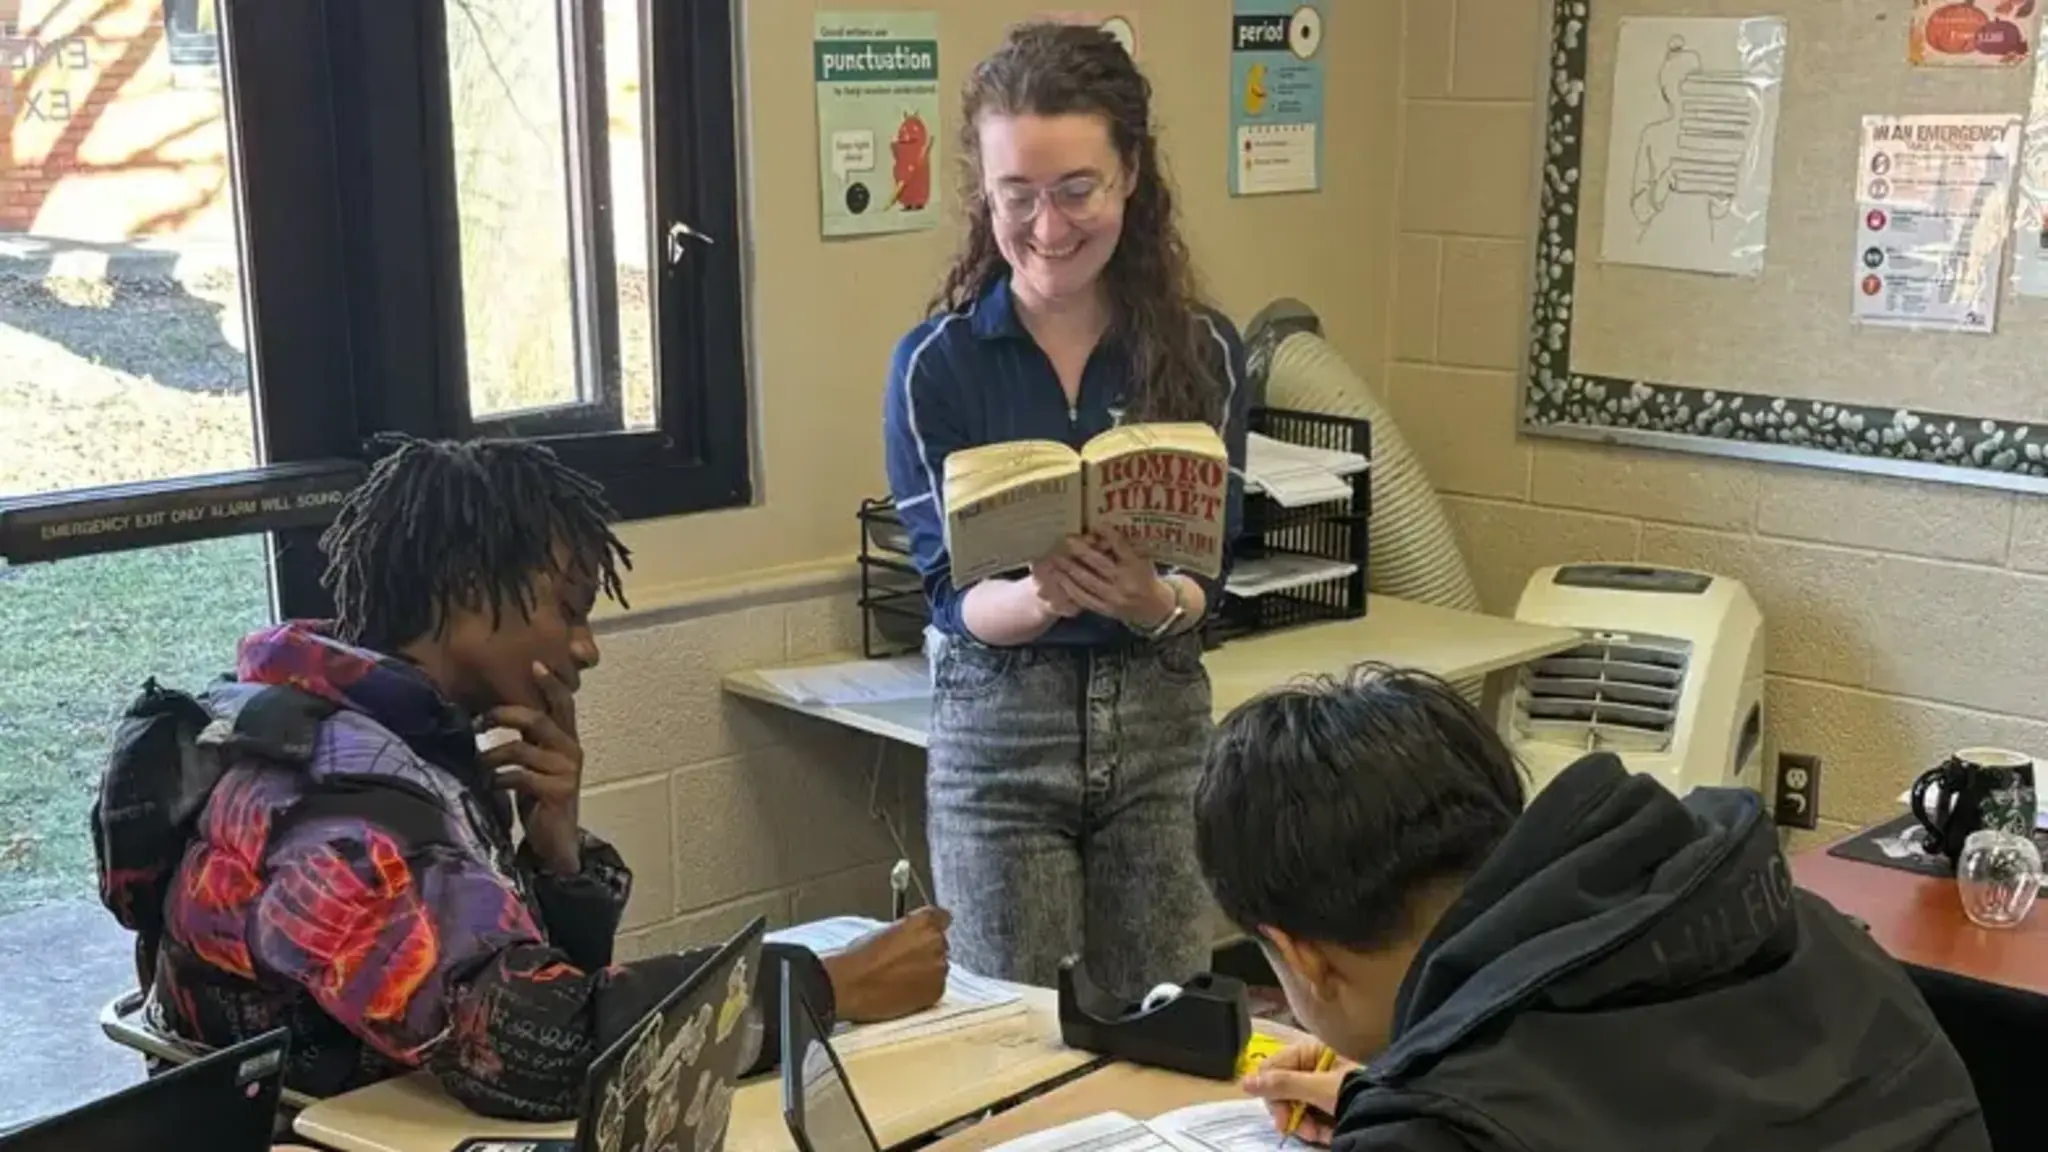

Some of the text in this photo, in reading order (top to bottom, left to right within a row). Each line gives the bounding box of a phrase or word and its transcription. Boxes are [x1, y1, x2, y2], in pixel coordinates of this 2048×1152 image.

[1239, 19, 1284, 48] period
[822, 43, 932, 79] punctuation
[1892, 125, 1912, 140] AN
[1917, 125, 2007, 143] EMERGENCY
[1100, 452, 1223, 488] ROMEO
[41, 490, 344, 540] EMERGENCY EXIT ONLY ALARM WILL SOUND
[1098, 485, 1221, 521] JULIET
